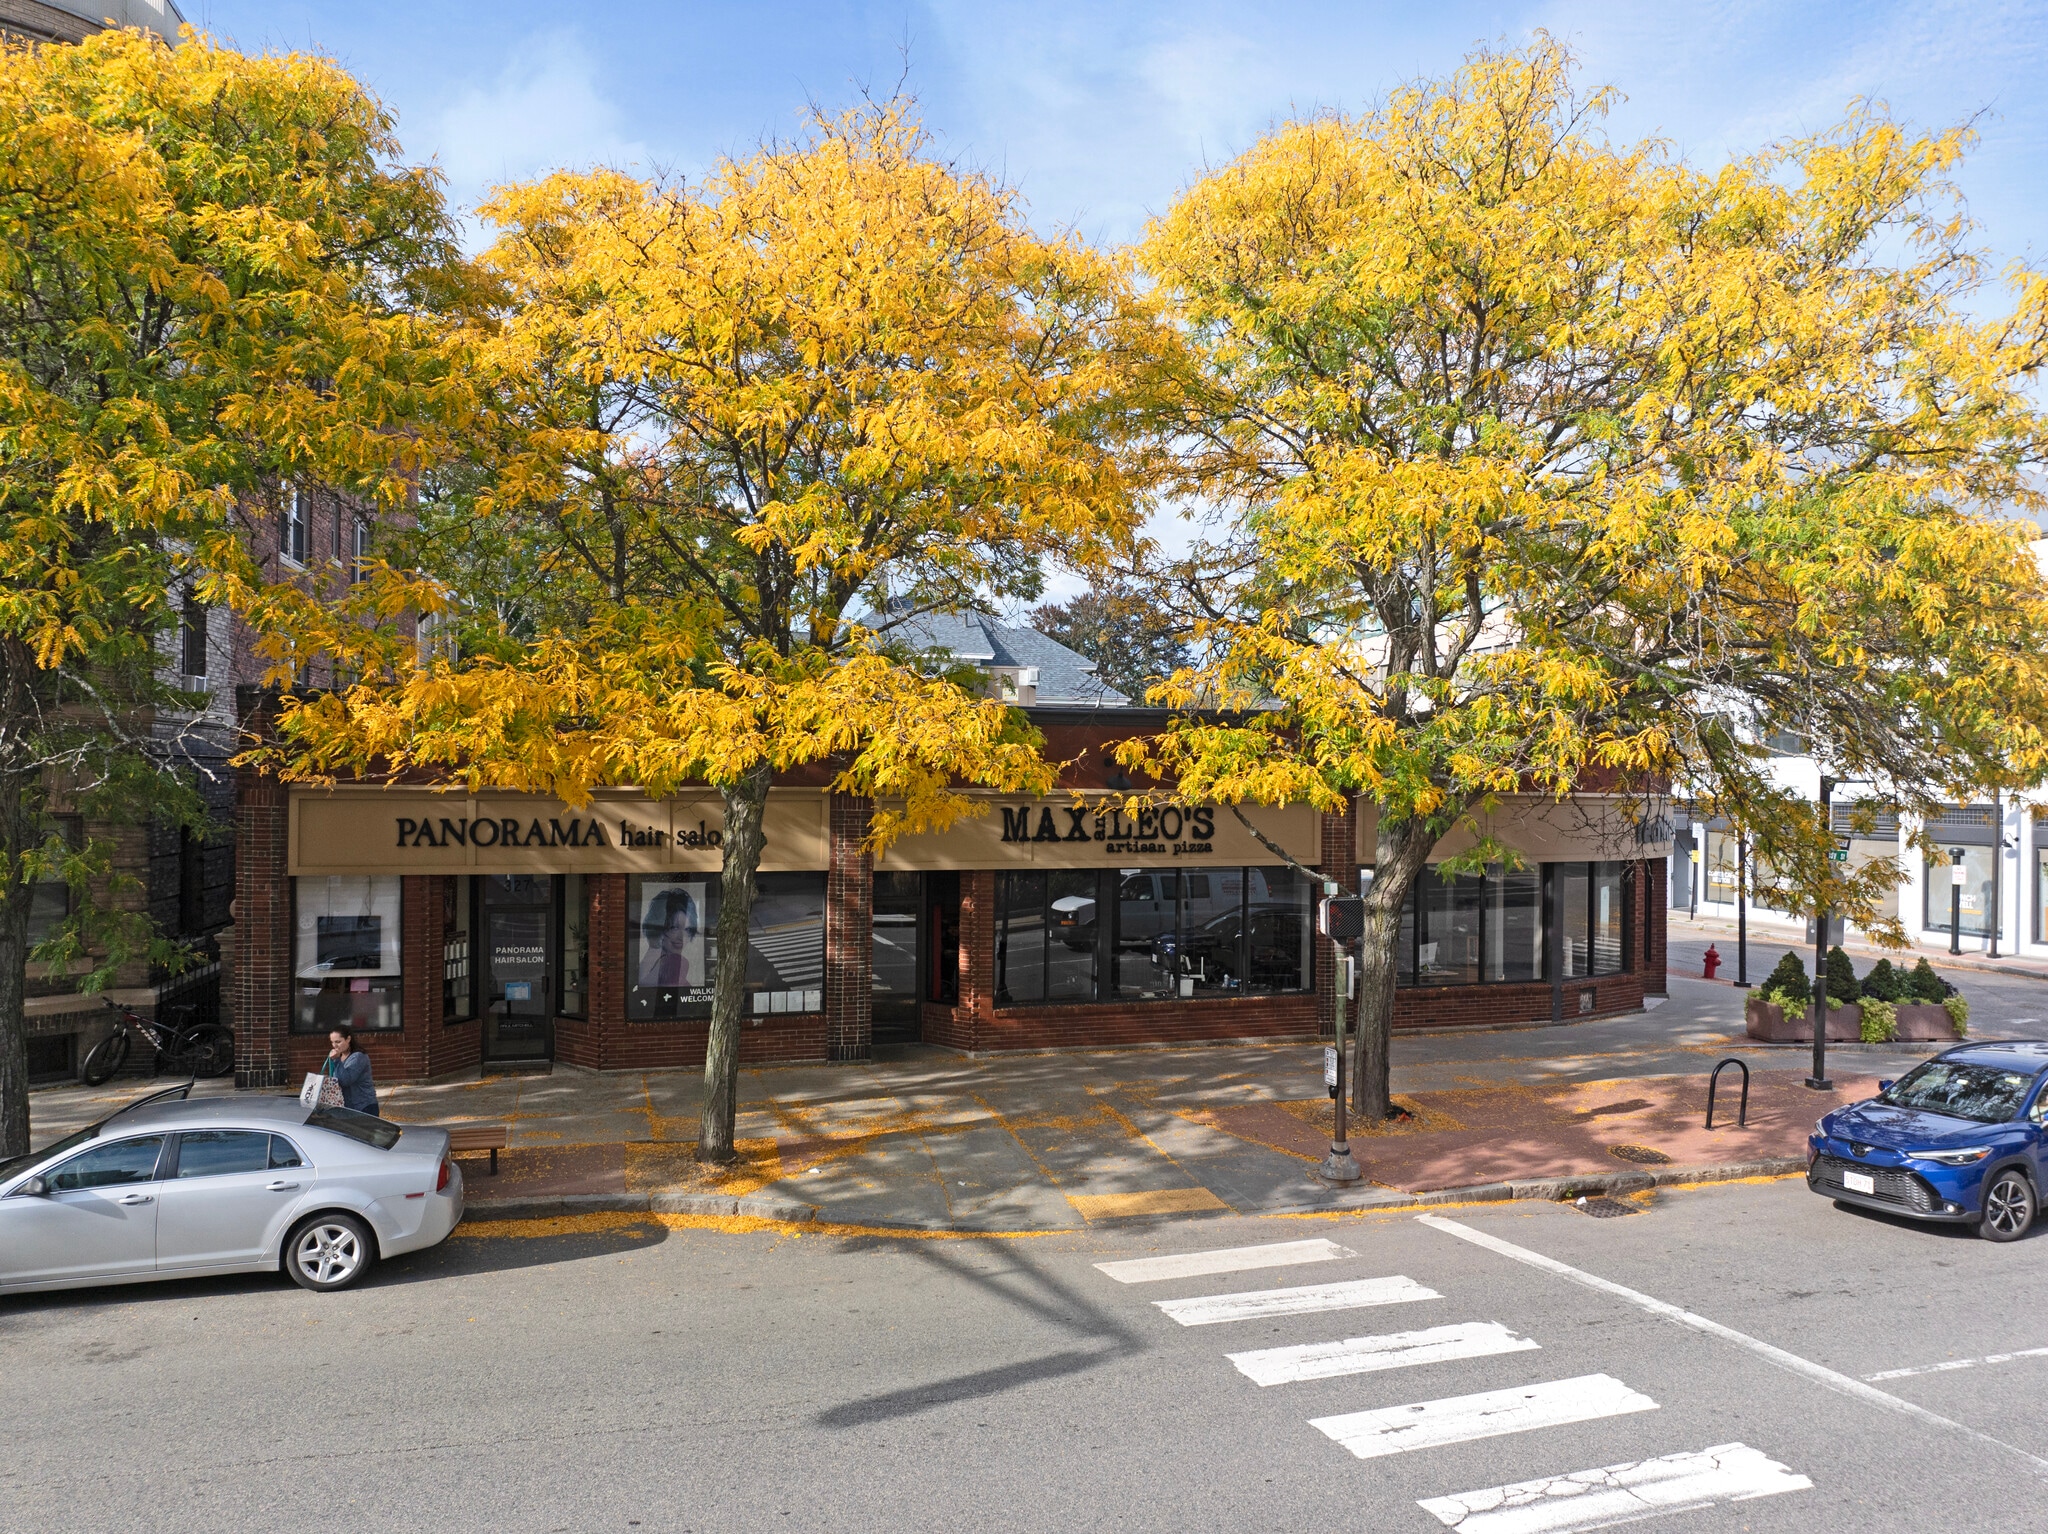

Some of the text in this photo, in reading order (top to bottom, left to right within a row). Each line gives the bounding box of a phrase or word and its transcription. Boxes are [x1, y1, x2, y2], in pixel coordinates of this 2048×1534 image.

[1001, 806, 1091, 842] MAX
[1107, 806, 1215, 840] LEO'S
[396, 818, 724, 847] PANORAMA hair salo
[1106, 840, 1213, 856] artisan pizza
[504, 879, 530, 894] 327
[495, 946, 544, 954] PANORAMA
[494, 955, 544, 964] HAIR SALON
[689, 987, 714, 995] WALKI
[680, 995, 714, 1003] WELCOM
